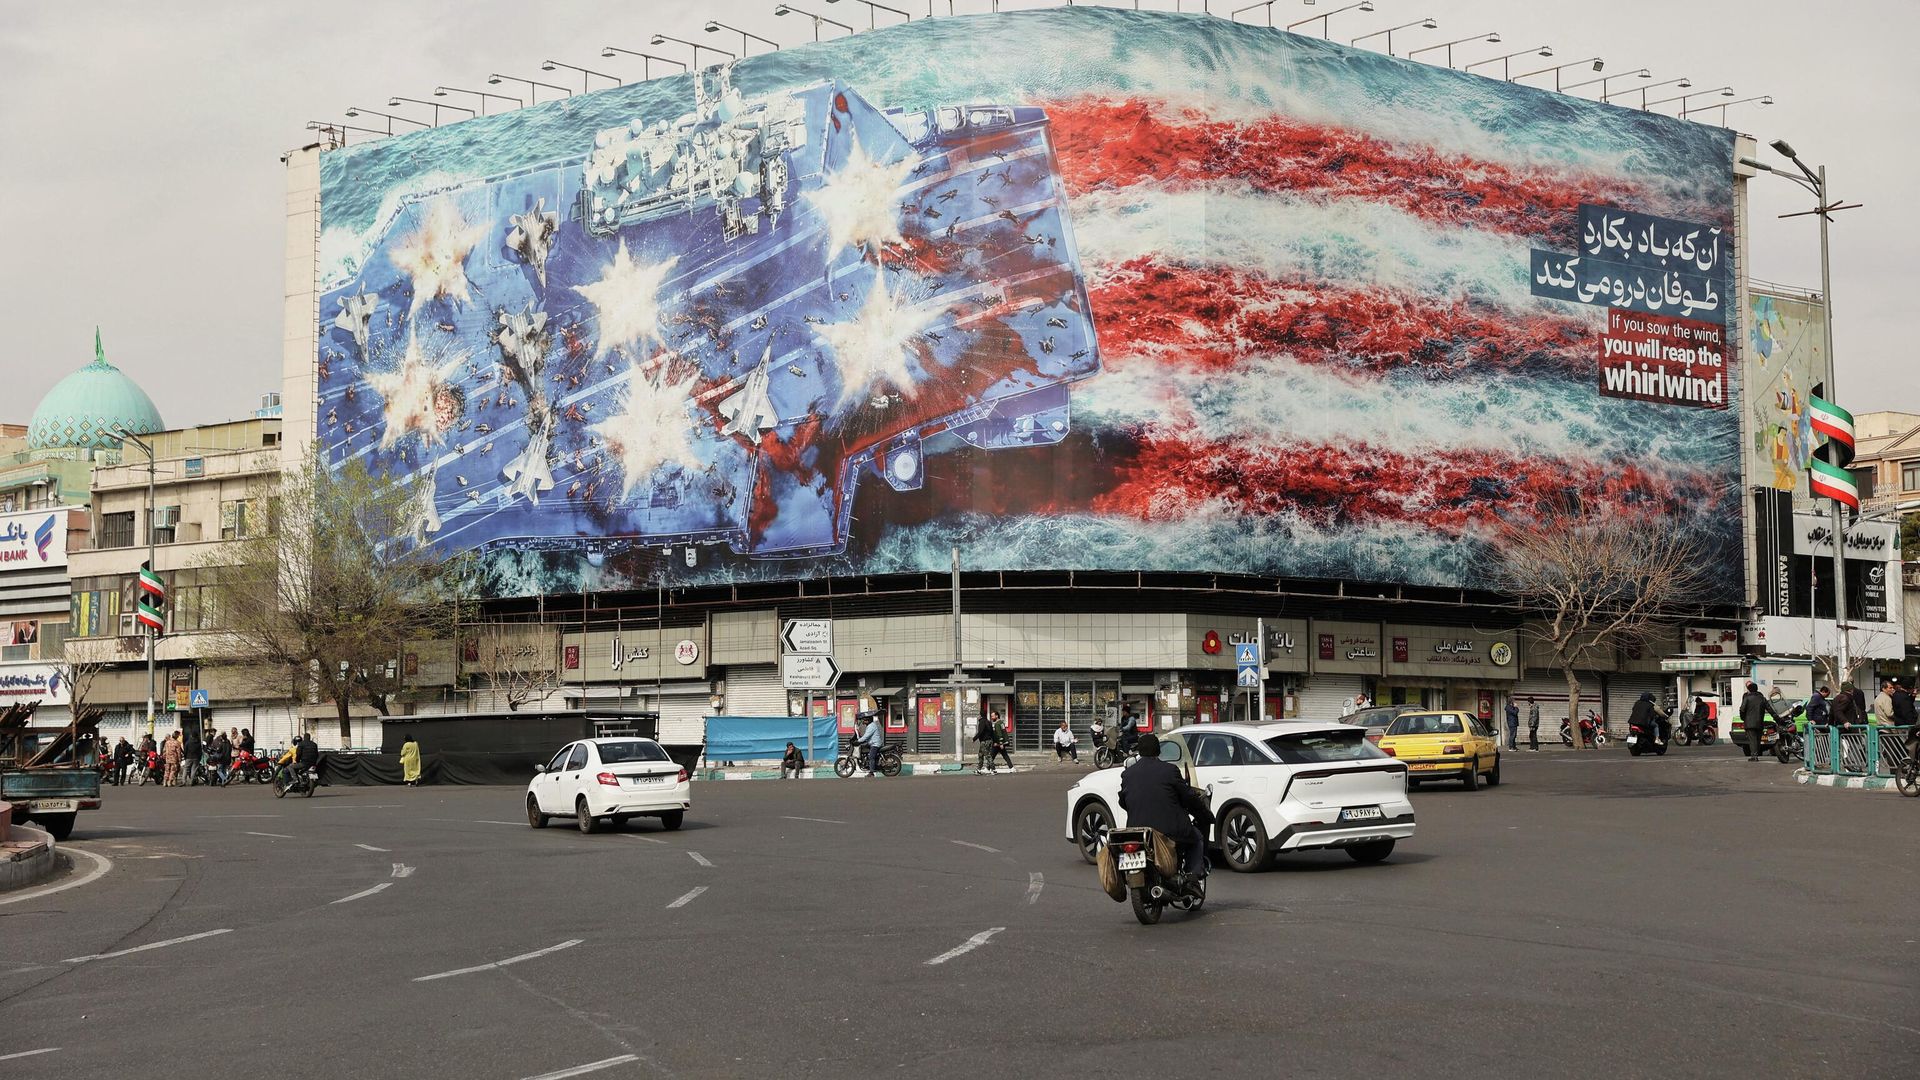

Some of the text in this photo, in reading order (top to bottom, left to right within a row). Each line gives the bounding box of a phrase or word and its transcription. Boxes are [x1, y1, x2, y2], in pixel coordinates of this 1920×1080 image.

[1583, 214, 1633, 260] بکارد
[1638, 222, 1669, 266] باد
[1611, 276, 1645, 307] درو
[1645, 271, 1719, 317] طوفان
[1612, 314, 1722, 345] If you sow the wind,
[1603, 337, 1722, 368] you will reap the
[1604, 360, 1722, 404] whirlwind
[4, 549, 28, 562] BANK
[1780, 554, 1790, 616] SAMSUNG
[626, 648, 650, 663] کفش
[1347, 646, 1376, 659] ساعتی
[1435, 640, 1473, 654] کفش ملی
